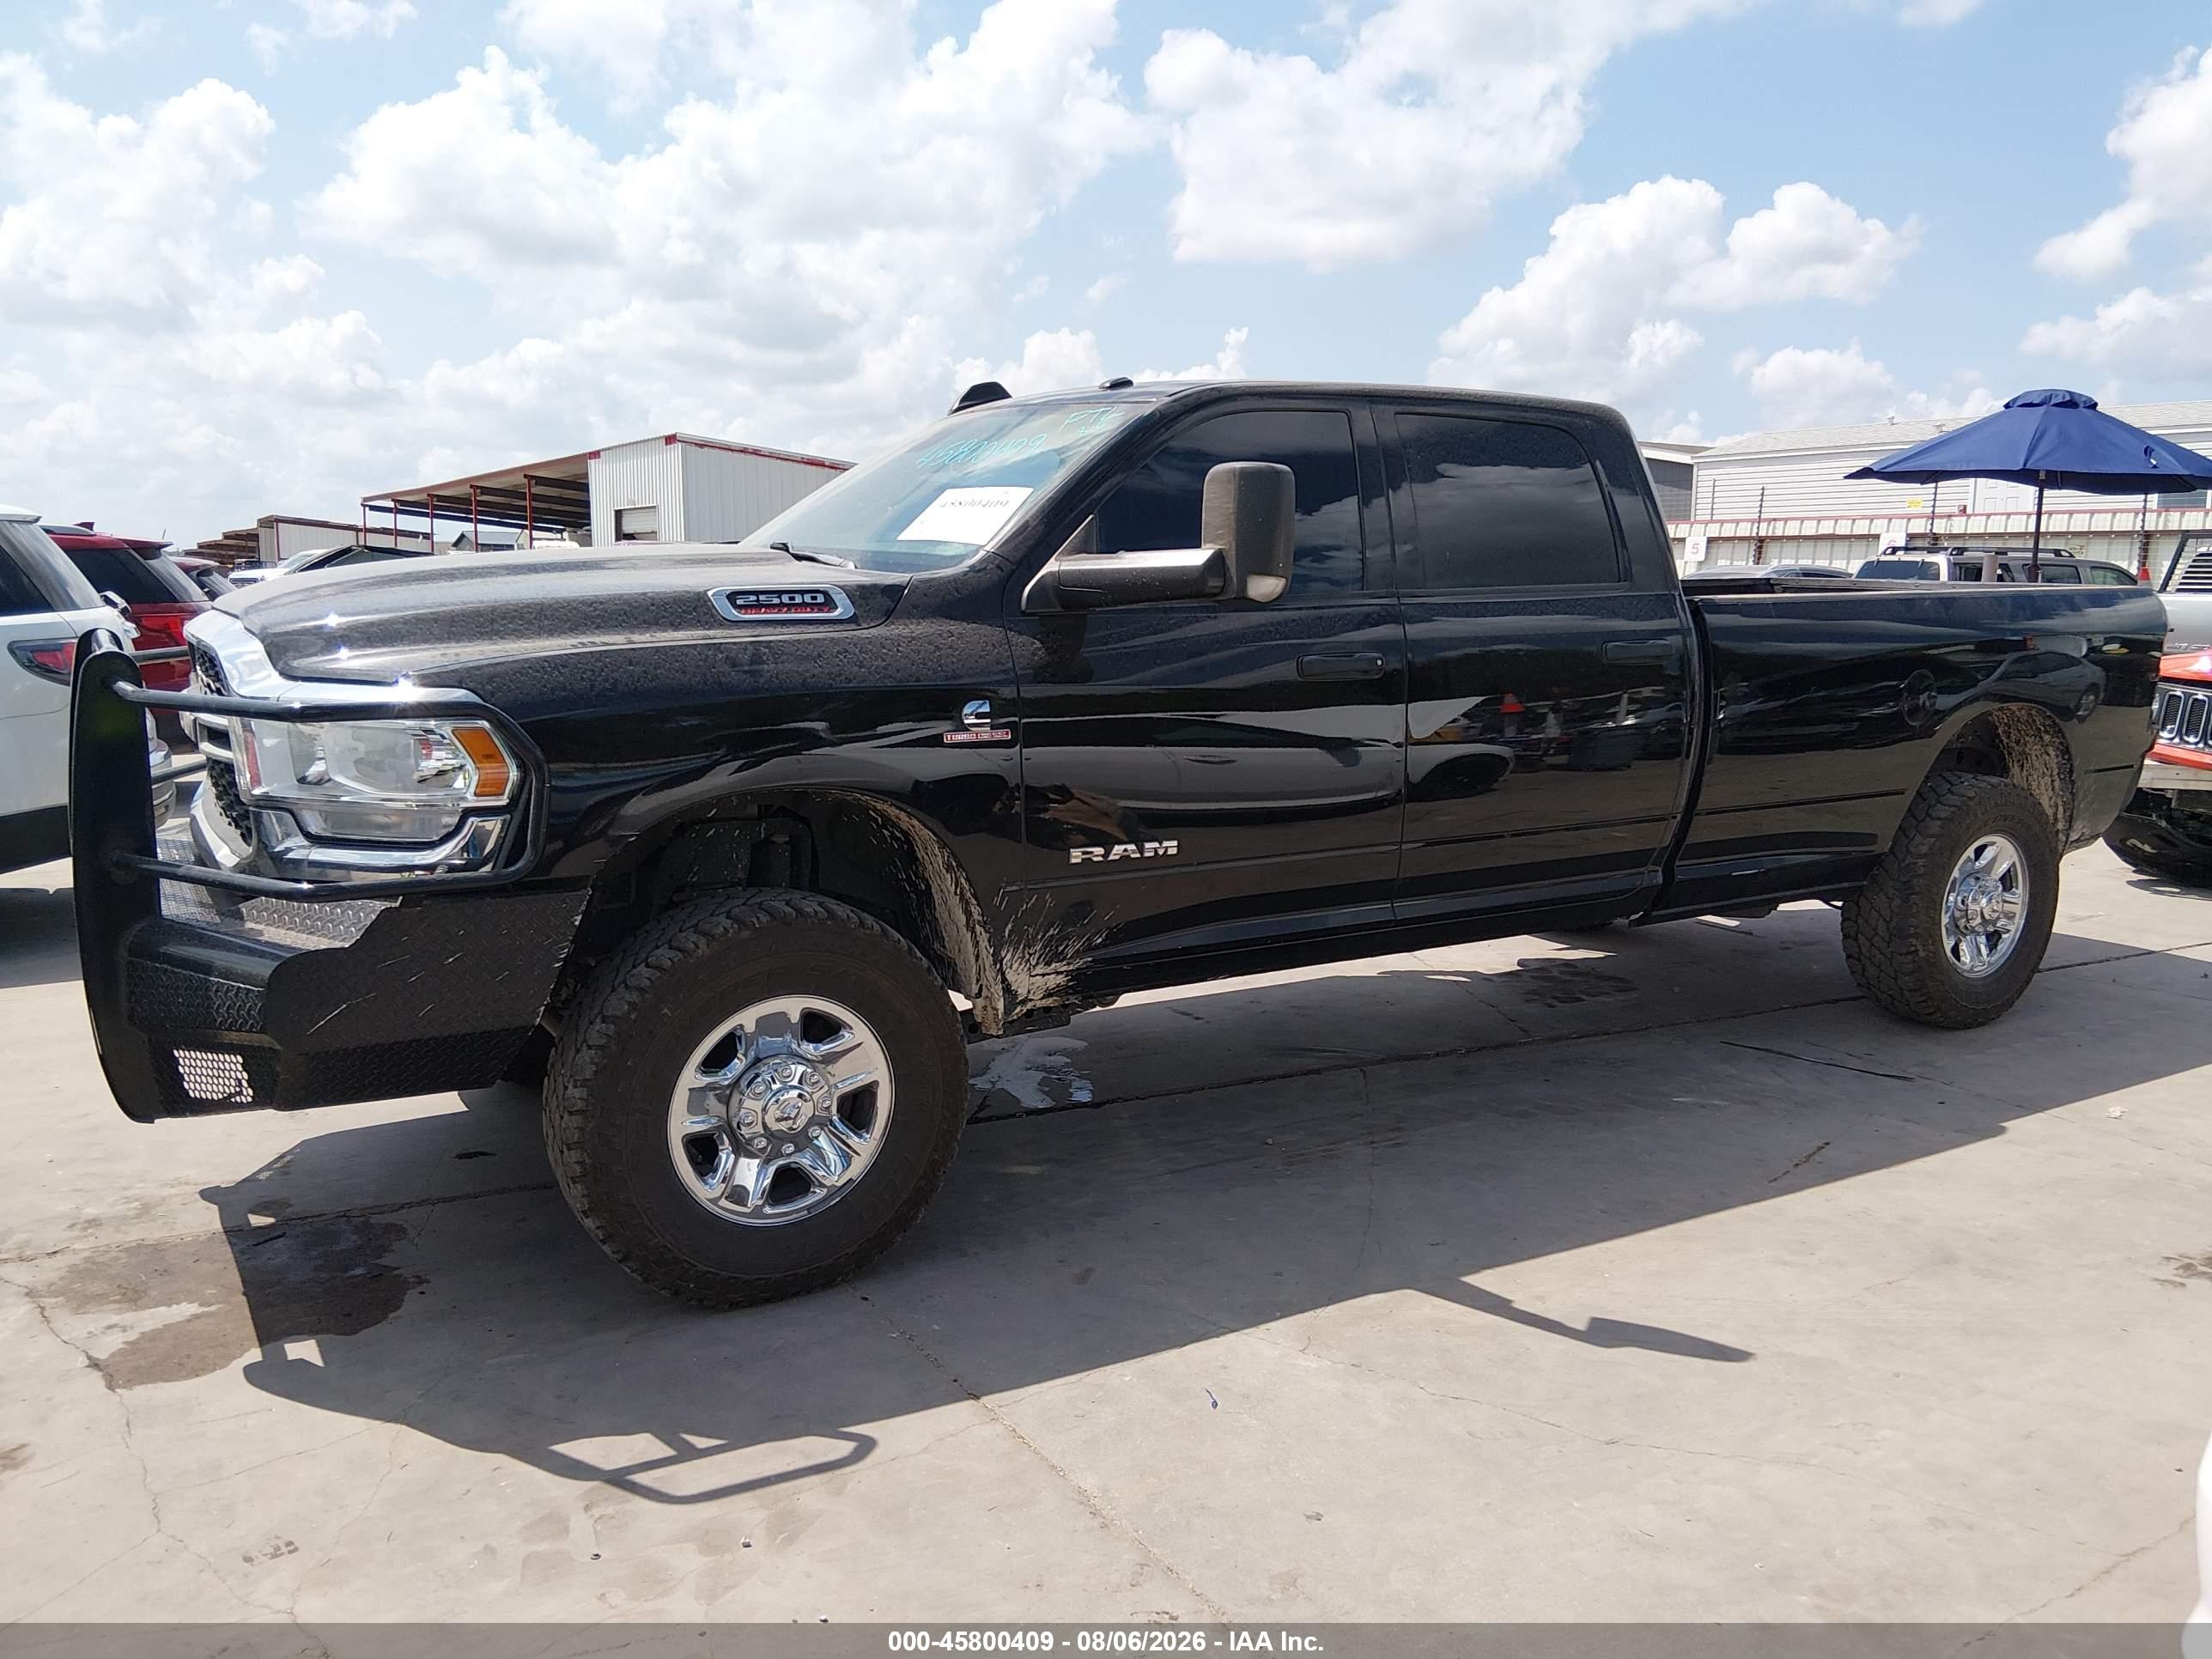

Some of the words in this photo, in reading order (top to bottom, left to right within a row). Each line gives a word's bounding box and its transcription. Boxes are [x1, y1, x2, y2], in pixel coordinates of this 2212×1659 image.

[1690, 543, 1699, 555] 5
[736, 593, 825, 605] 2500
[1070, 840, 1178, 864] RAM
